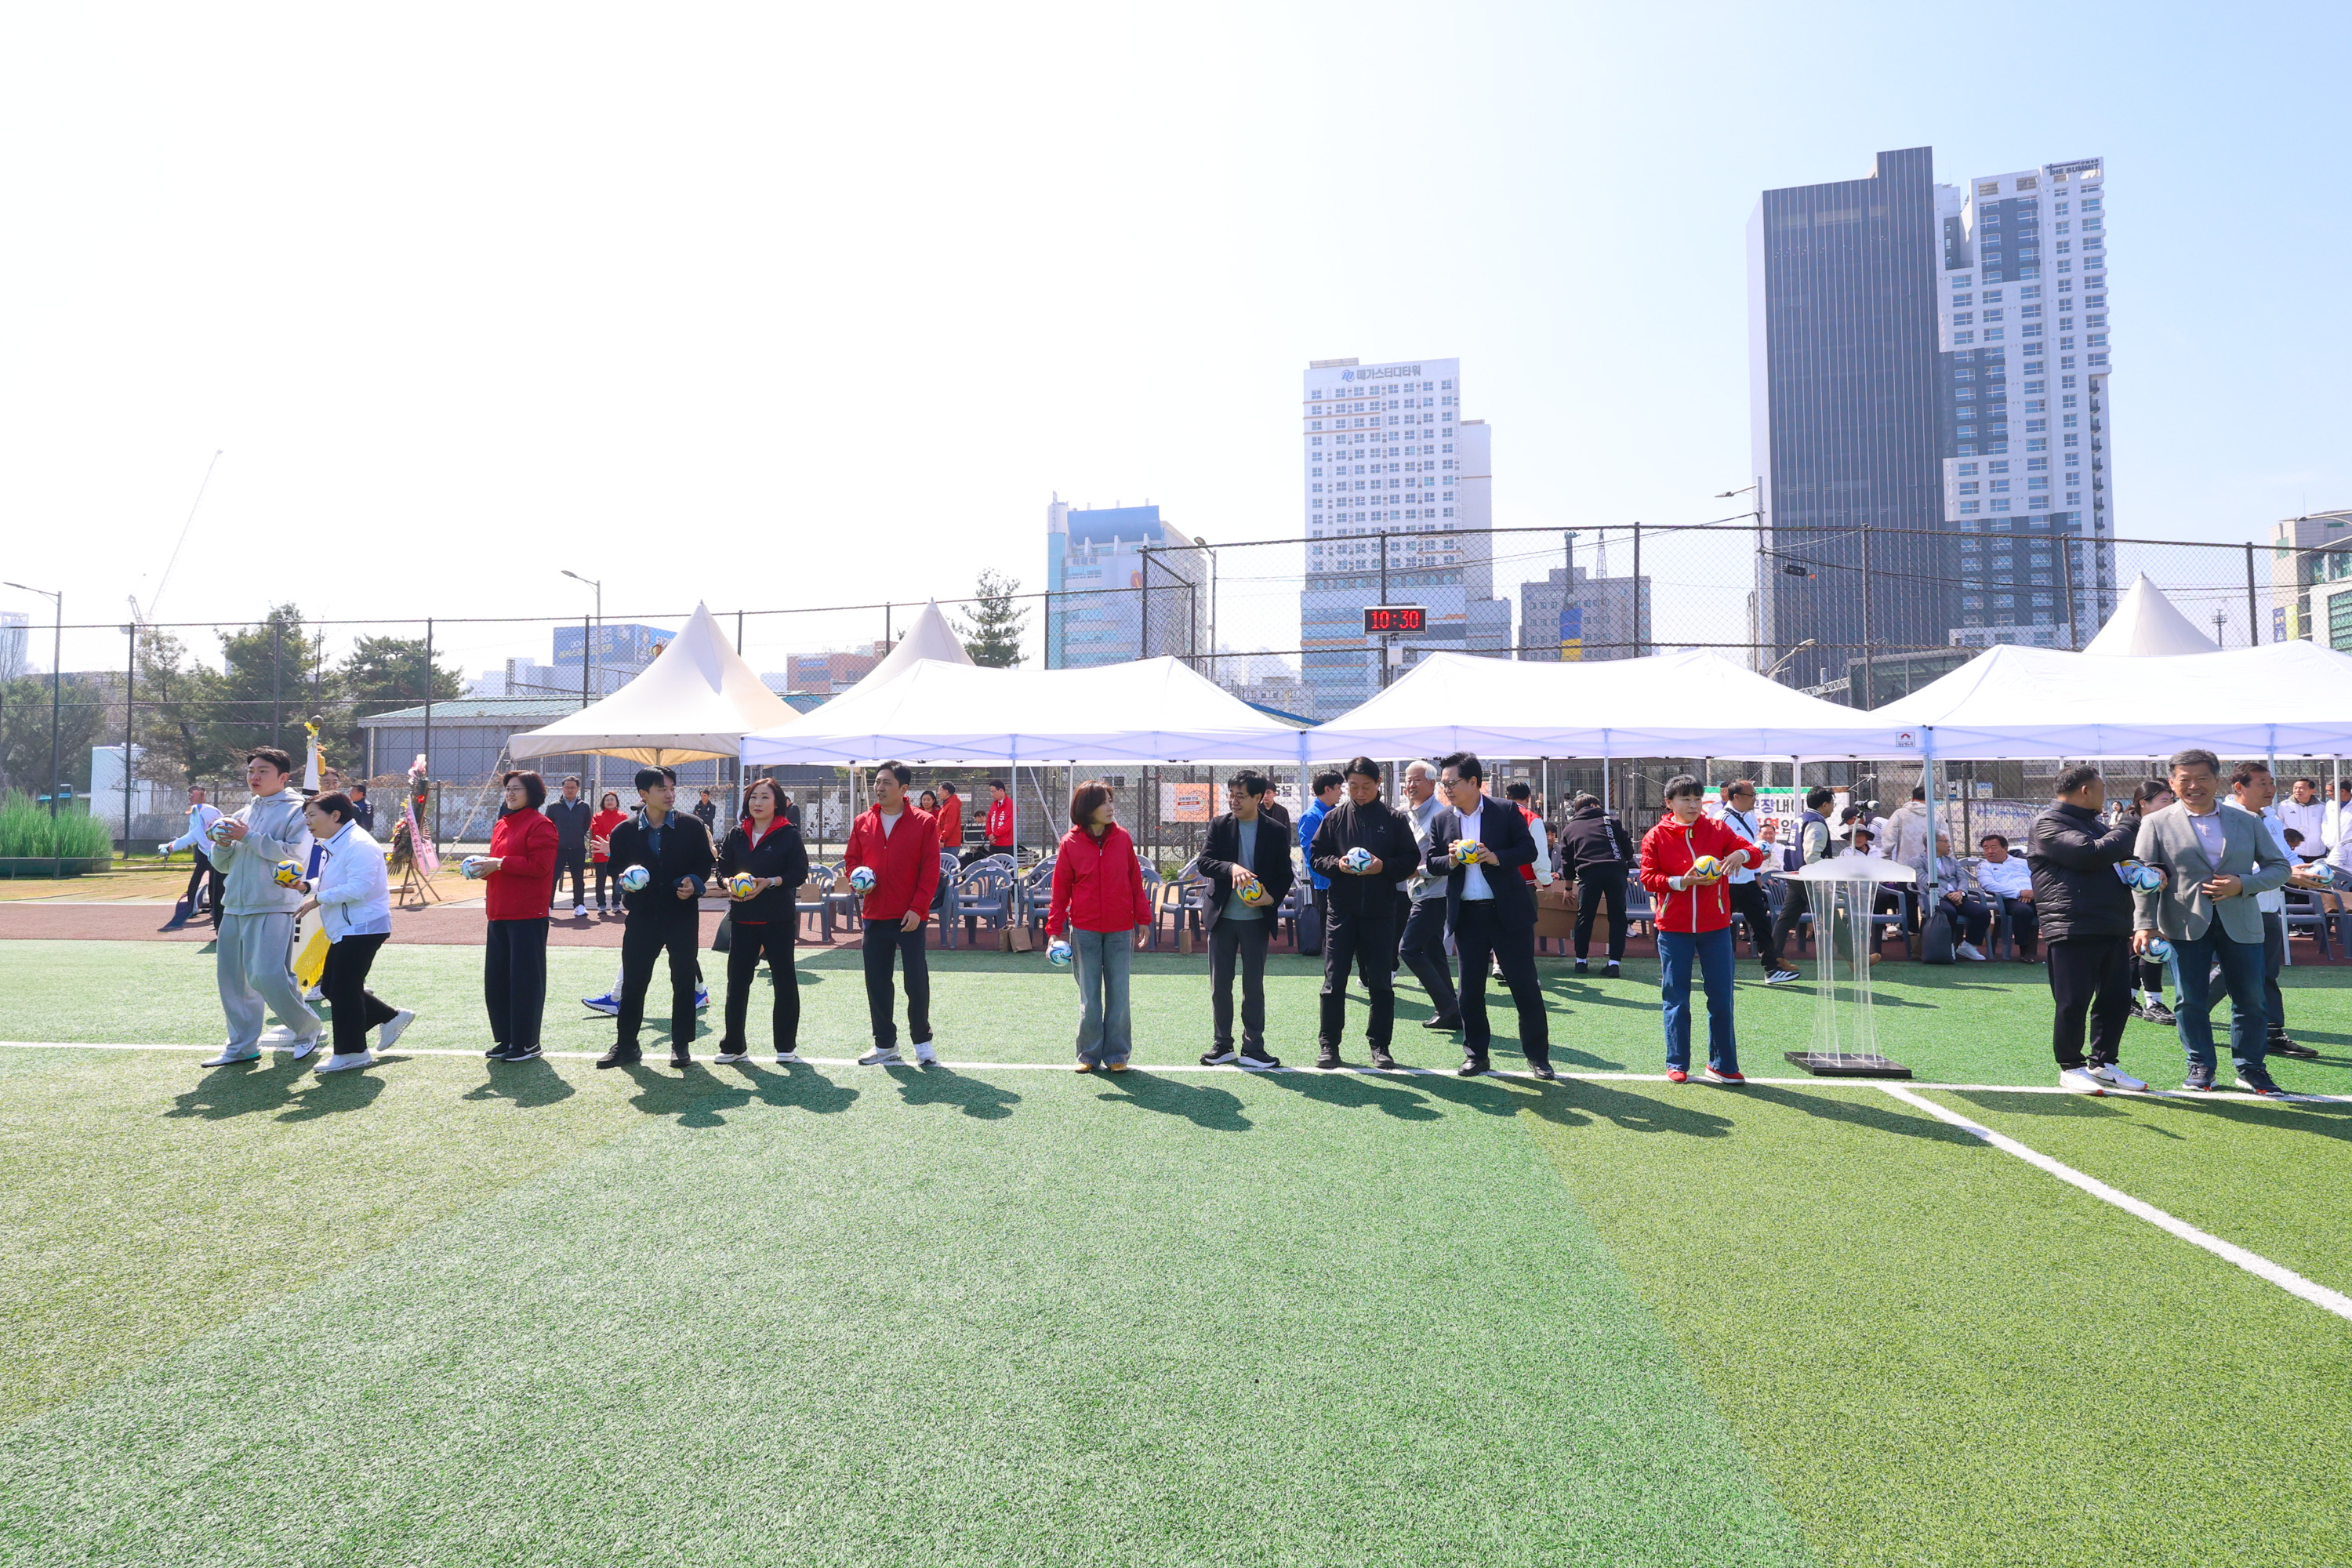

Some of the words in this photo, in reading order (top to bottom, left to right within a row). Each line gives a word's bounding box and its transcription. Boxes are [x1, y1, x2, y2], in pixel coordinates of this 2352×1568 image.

[2066, 163, 2100, 173] SUMMIT
[1356, 365, 1421, 380] 메가스터디타워
[1370, 610, 1421, 630] 10:30
